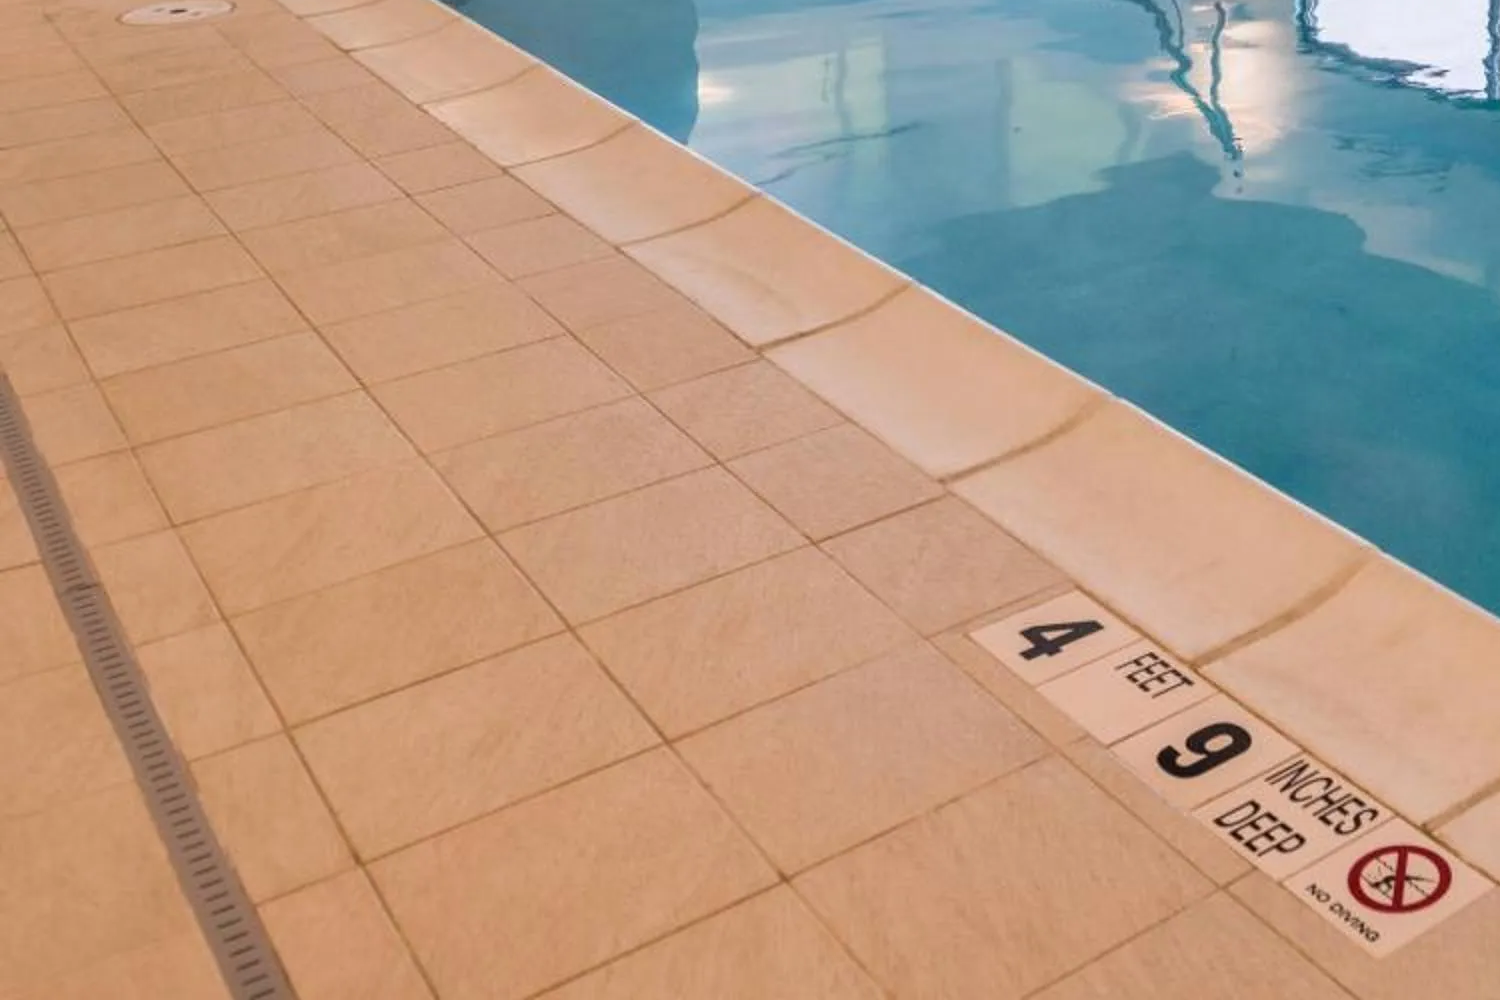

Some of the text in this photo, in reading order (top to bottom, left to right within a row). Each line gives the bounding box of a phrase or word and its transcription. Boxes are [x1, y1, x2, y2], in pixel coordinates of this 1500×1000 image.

[1018, 619, 1379, 836] 4 FEET 9 INCHES
[1212, 799, 1307, 858] DEEP
[1304, 883, 1380, 943] NO DIVING
